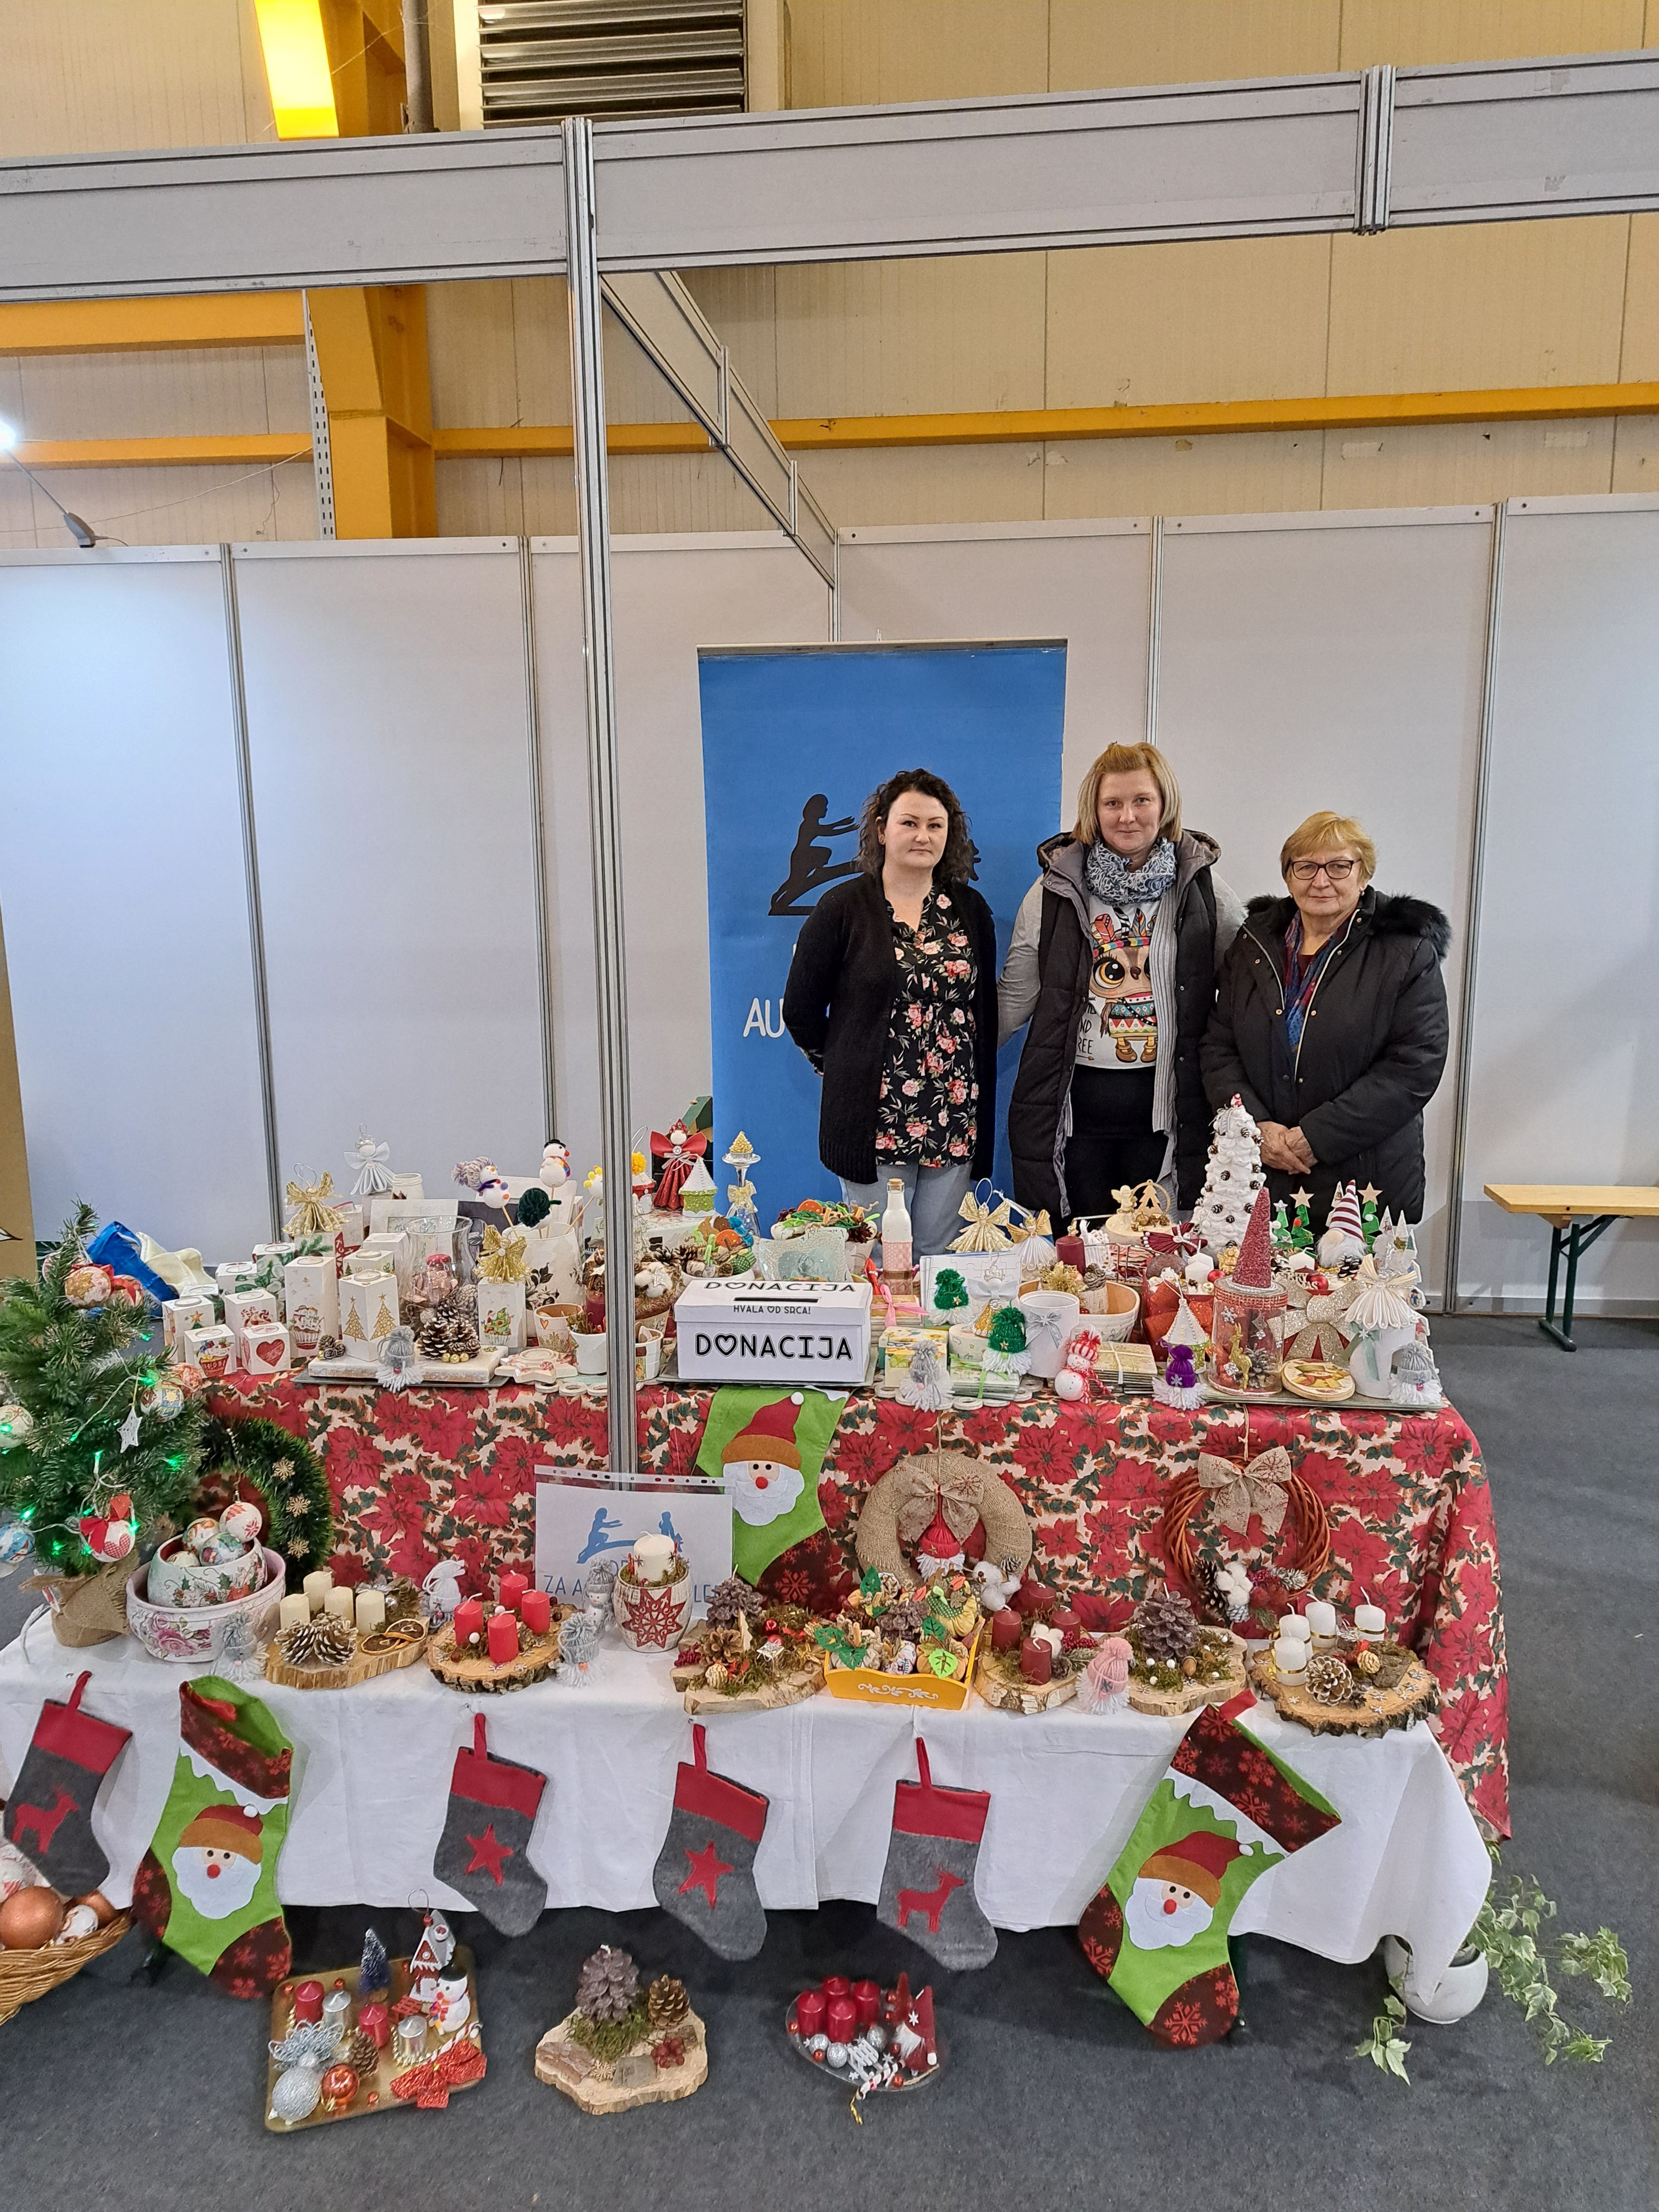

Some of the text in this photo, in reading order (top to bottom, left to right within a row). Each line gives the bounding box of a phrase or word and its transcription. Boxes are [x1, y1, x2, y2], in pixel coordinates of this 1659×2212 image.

[1078, 1037, 1094, 1054] REE
[704, 1282, 856, 1292] DONACIJA
[733, 1305, 811, 1315] HVALA OD SRCA!
[695, 1333, 853, 1361] DONACIJA
[544, 1575, 566, 1595] ZA
